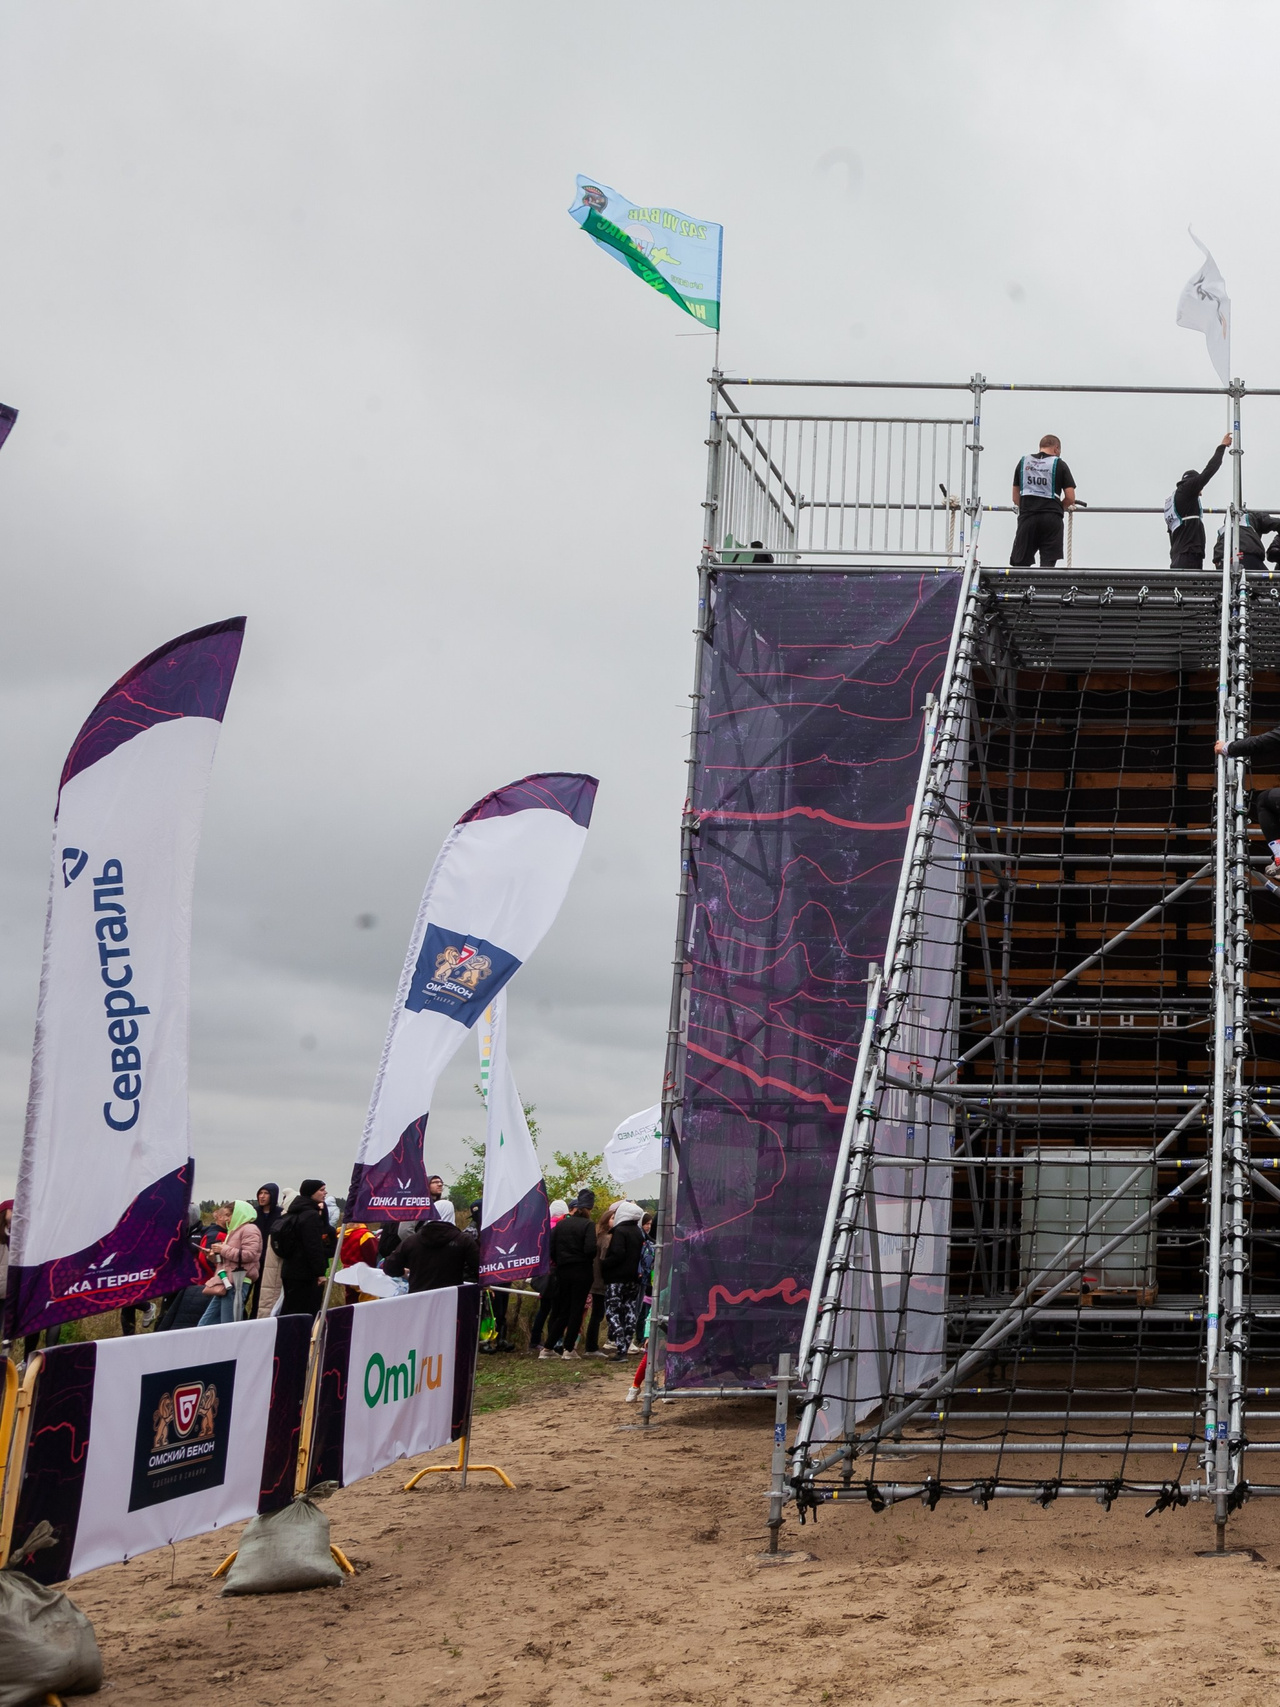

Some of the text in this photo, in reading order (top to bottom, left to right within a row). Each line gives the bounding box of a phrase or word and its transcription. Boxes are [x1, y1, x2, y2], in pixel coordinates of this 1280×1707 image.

[1027, 476, 1048, 486] 5100
[93, 858, 151, 1132] Северсталь
[368, 1196, 430, 1206] ГОНКА ГЕРОЕВ
[478, 1262, 504, 1274] ОНКА
[507, 1256, 540, 1268] ГЕРОЕВ
[364, 1349, 442, 1408] Om1.ru
[148, 1440, 216, 1468] ОМСКИЙ БЕКОН
